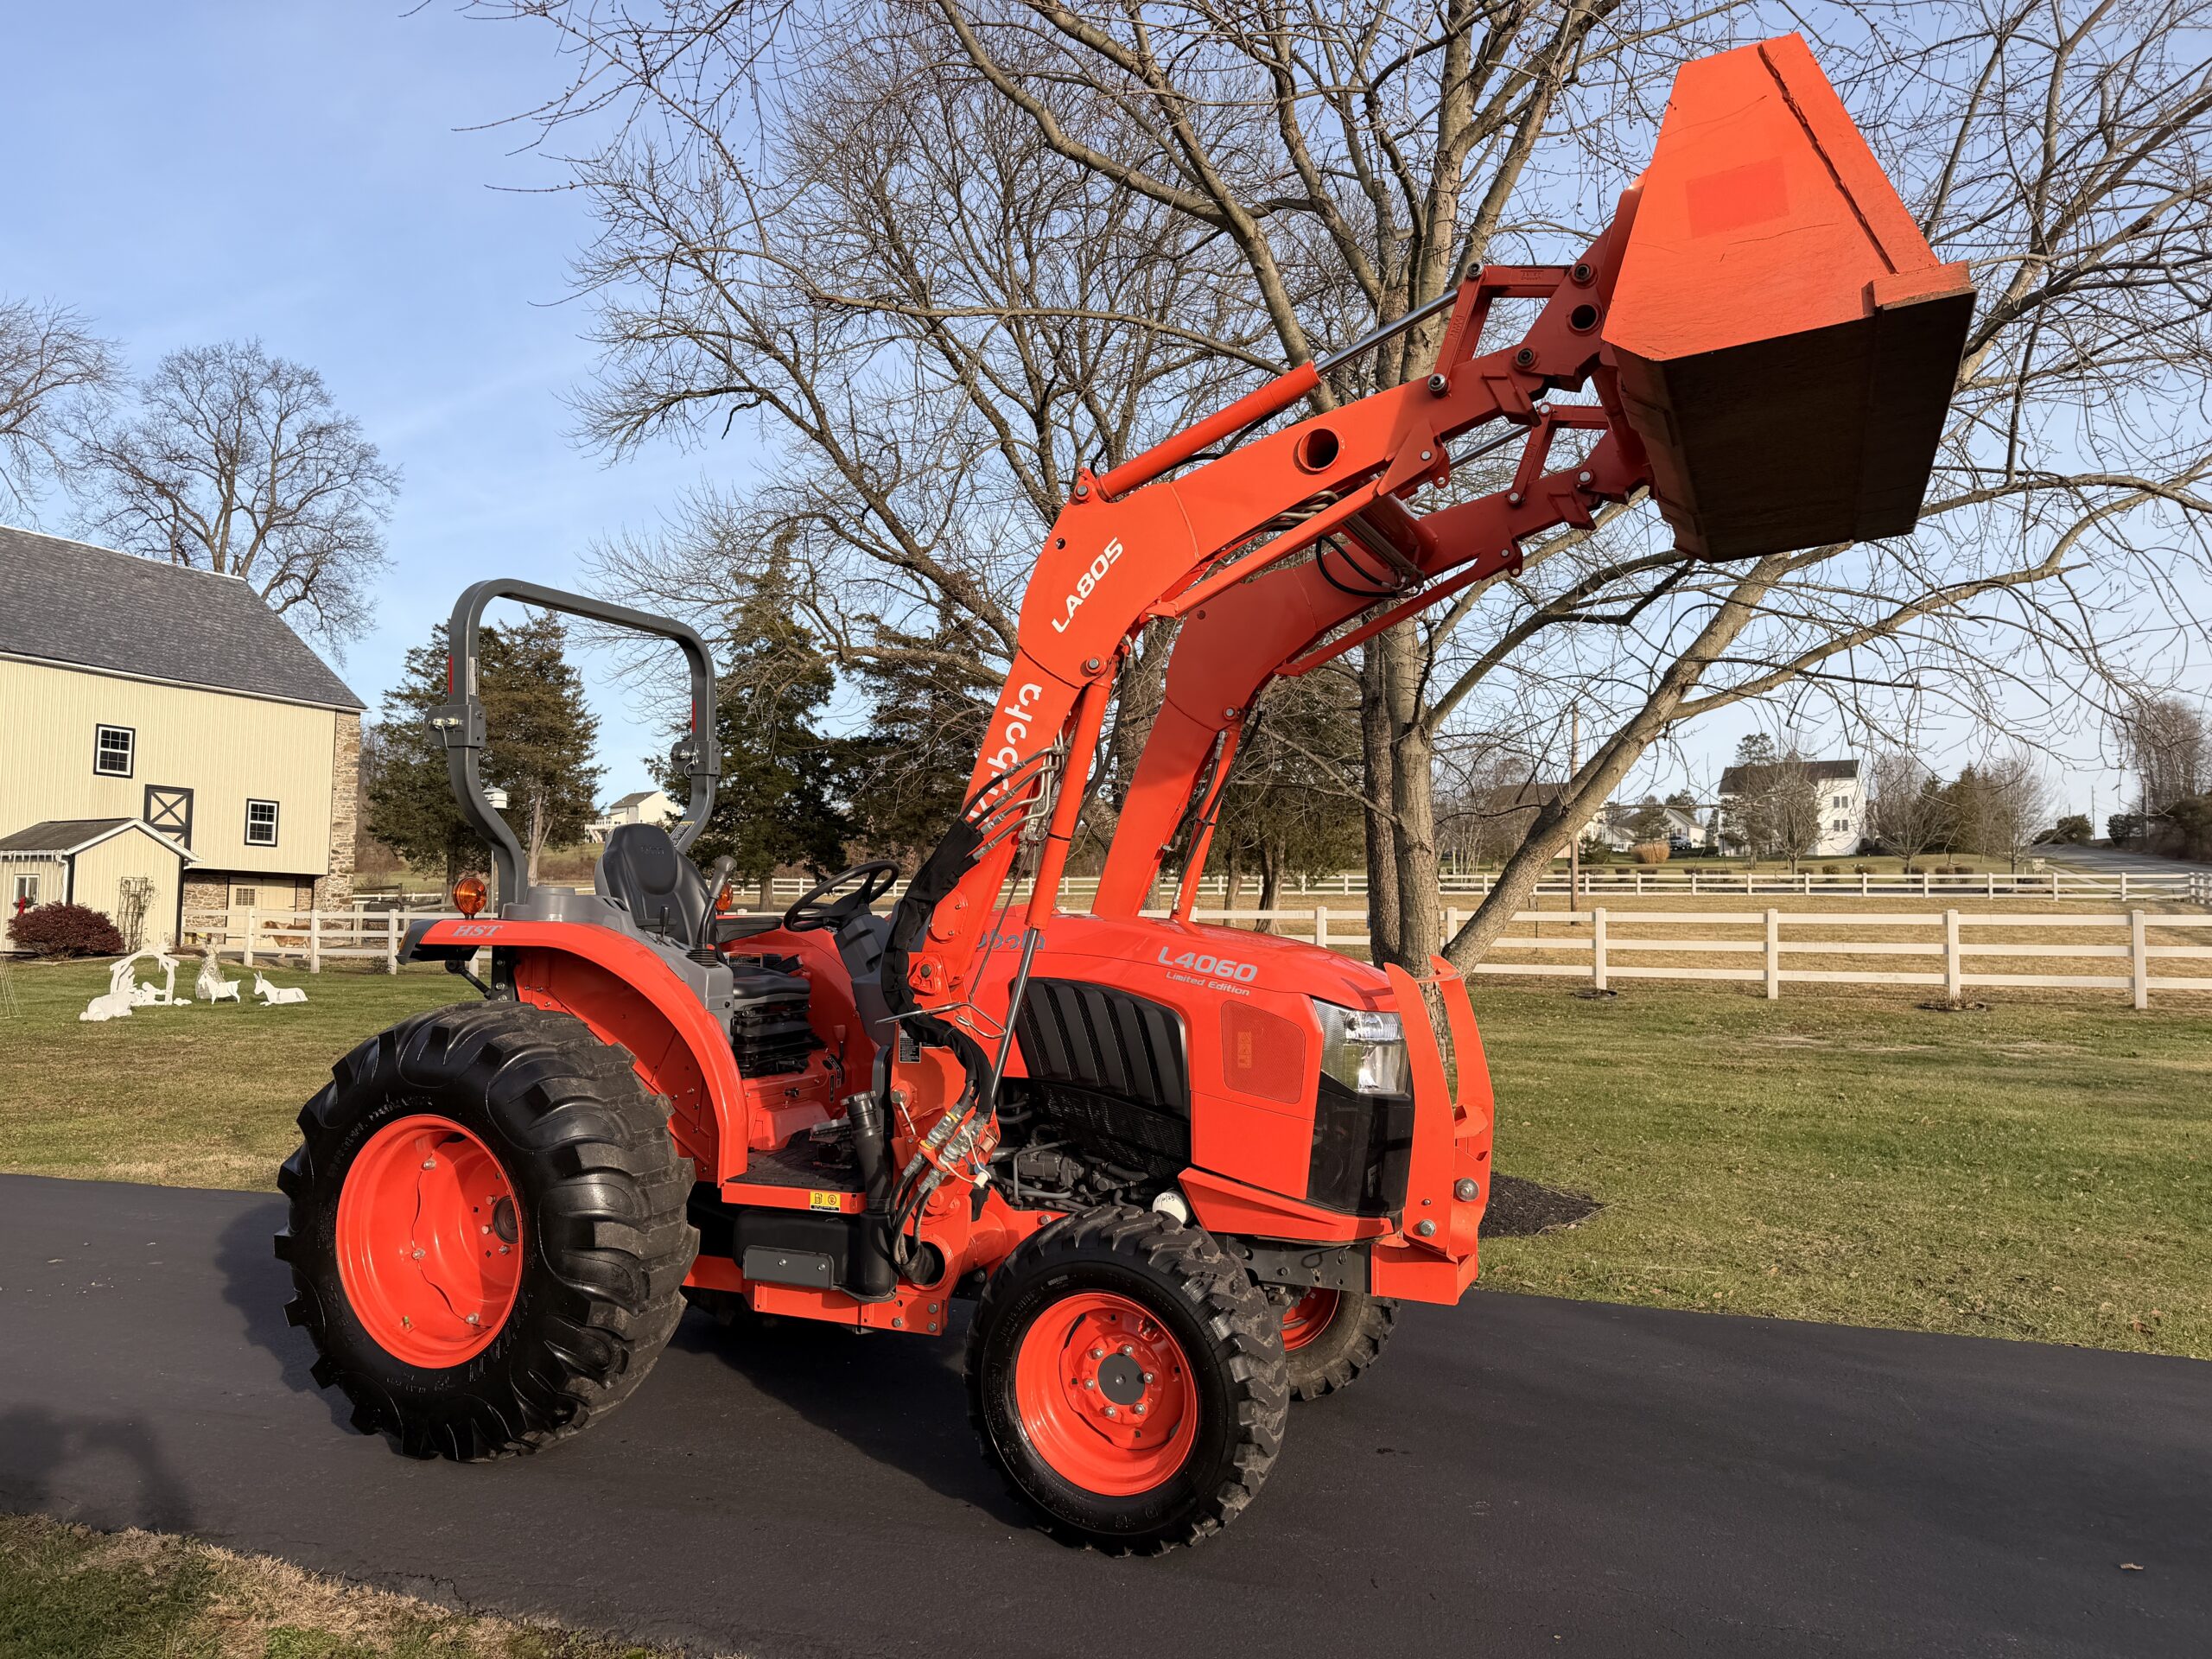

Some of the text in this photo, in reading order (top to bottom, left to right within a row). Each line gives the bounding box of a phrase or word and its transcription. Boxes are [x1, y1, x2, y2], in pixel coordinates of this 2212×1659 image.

[1052, 537, 1123, 633] LA805
[452, 925, 503, 938] HST
[976, 928, 1045, 950] bota
[1158, 946, 1258, 982] L4060
[1166, 971, 1250, 996] Limited Edition
